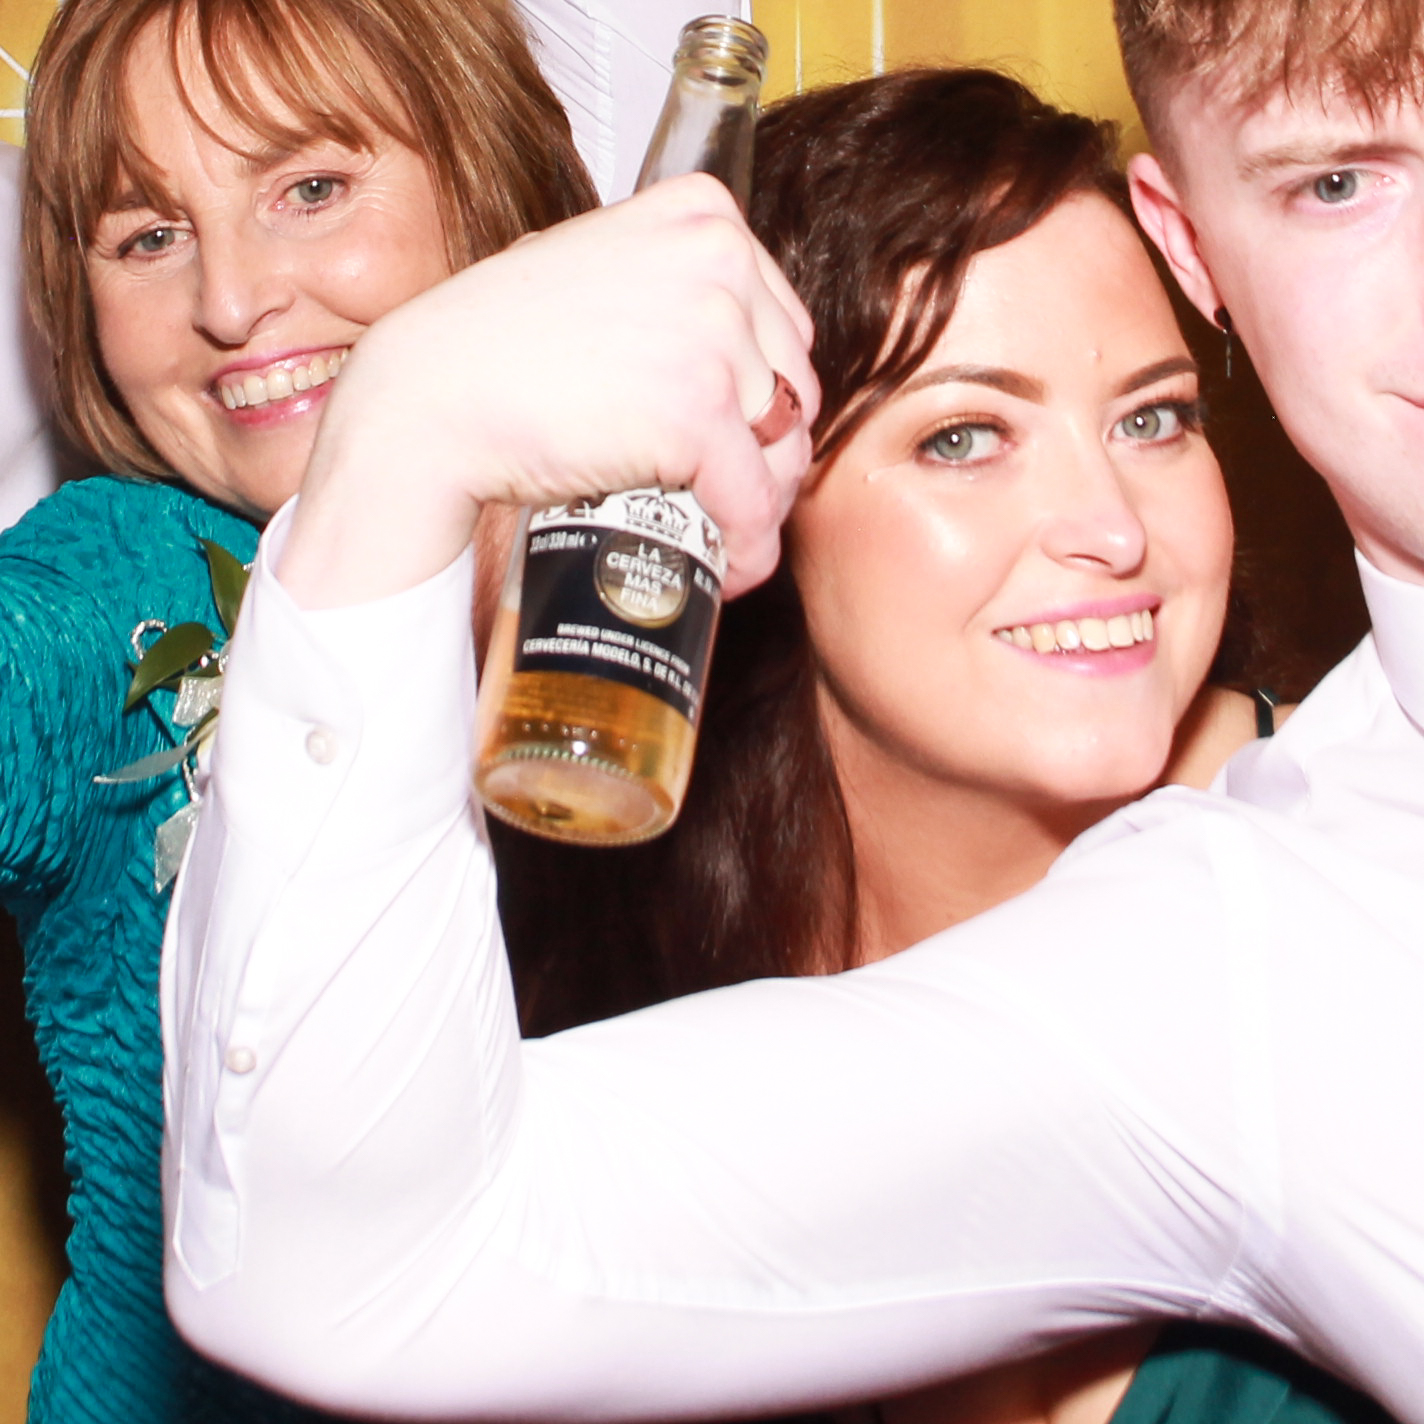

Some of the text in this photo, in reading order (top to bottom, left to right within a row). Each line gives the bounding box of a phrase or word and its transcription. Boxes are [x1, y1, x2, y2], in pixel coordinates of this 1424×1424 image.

[638, 542, 661, 563] LA
[606, 551, 682, 591] CERVEZA
[624, 572, 662, 596] MAS
[620, 587, 658, 612] FINA
[557, 623, 600, 639] BREWED
[601, 628, 635, 648] UNDER
[654, 662, 668, 679] DE
